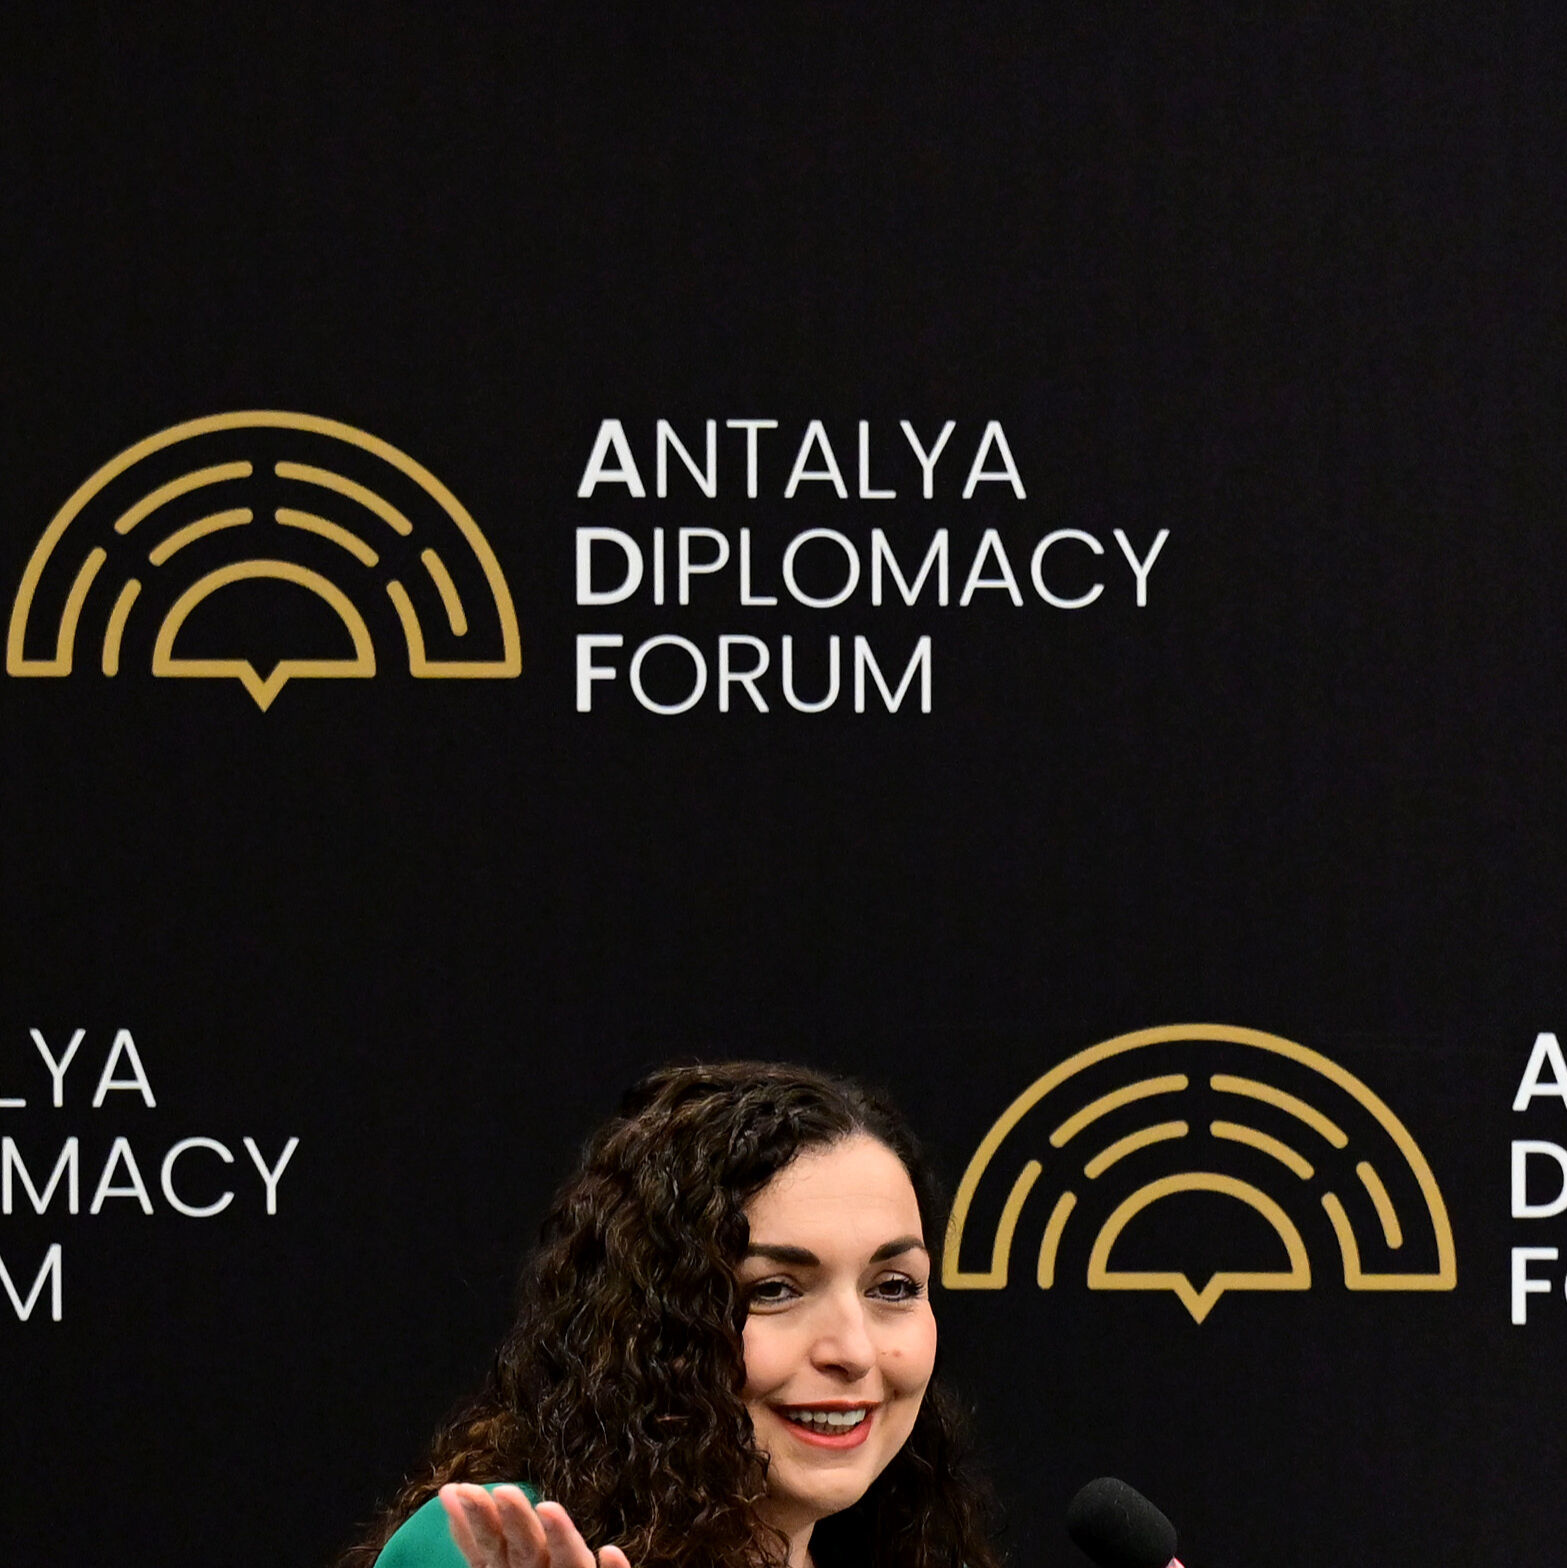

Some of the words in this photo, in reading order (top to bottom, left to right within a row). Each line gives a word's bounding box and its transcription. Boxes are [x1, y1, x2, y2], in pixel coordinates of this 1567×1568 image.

[577, 418, 1027, 500] ANTALYA
[575, 527, 1170, 609] DIPLOMACY
[575, 634, 932, 715] FORUM
